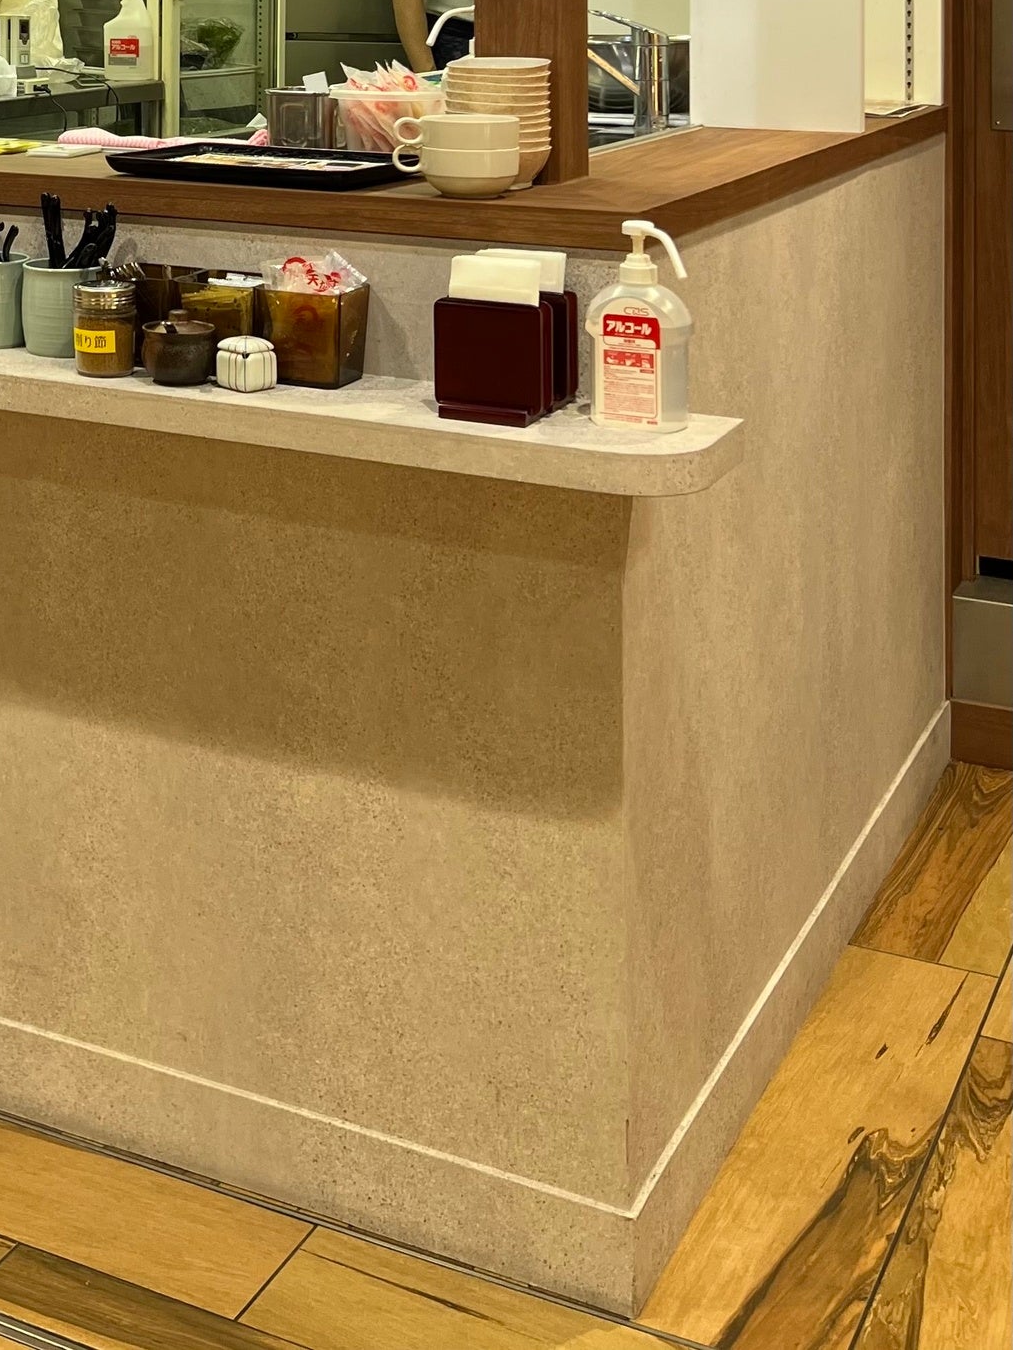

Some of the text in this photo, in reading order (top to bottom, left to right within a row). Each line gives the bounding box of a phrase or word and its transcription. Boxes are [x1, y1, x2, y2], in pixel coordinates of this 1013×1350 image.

[606, 320, 652, 335] アルコール
